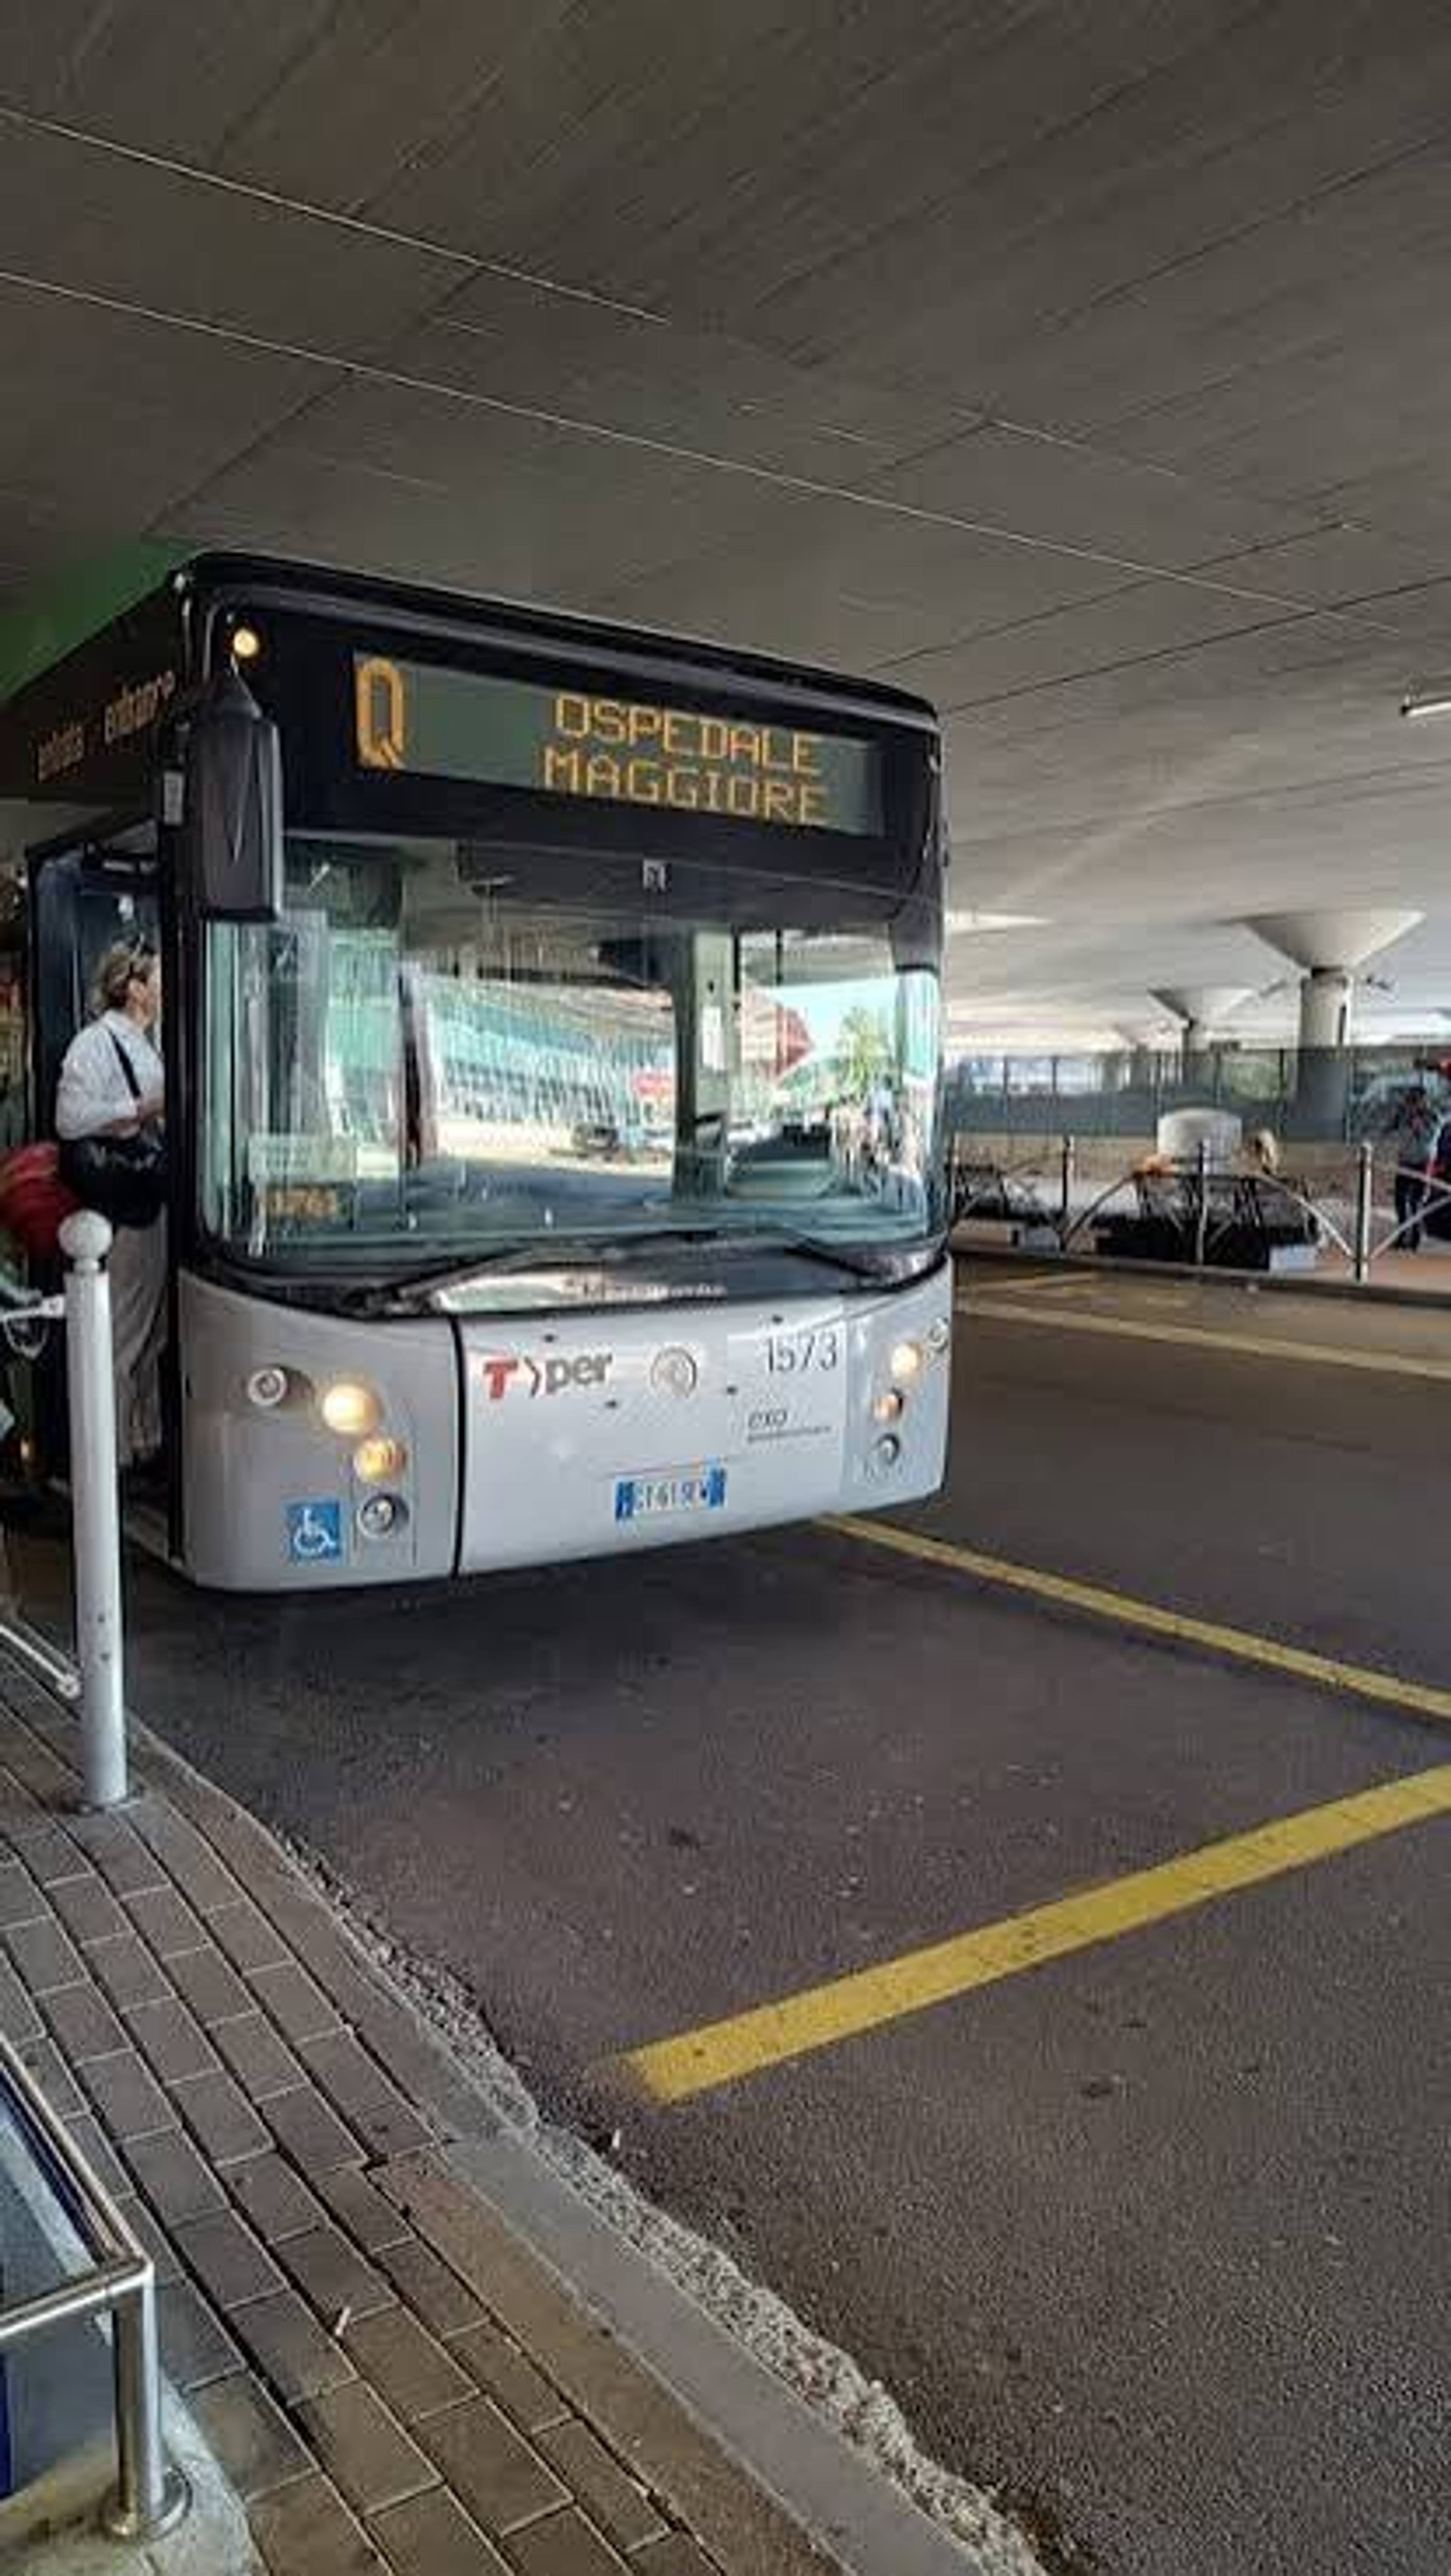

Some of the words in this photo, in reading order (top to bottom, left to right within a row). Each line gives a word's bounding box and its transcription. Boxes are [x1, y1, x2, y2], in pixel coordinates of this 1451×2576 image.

[357, 657, 406, 769] Q
[555, 693, 824, 775] OSPEDALE
[544, 746, 831, 825] MAGGIORE
[767, 1330, 837, 1372] 1573
